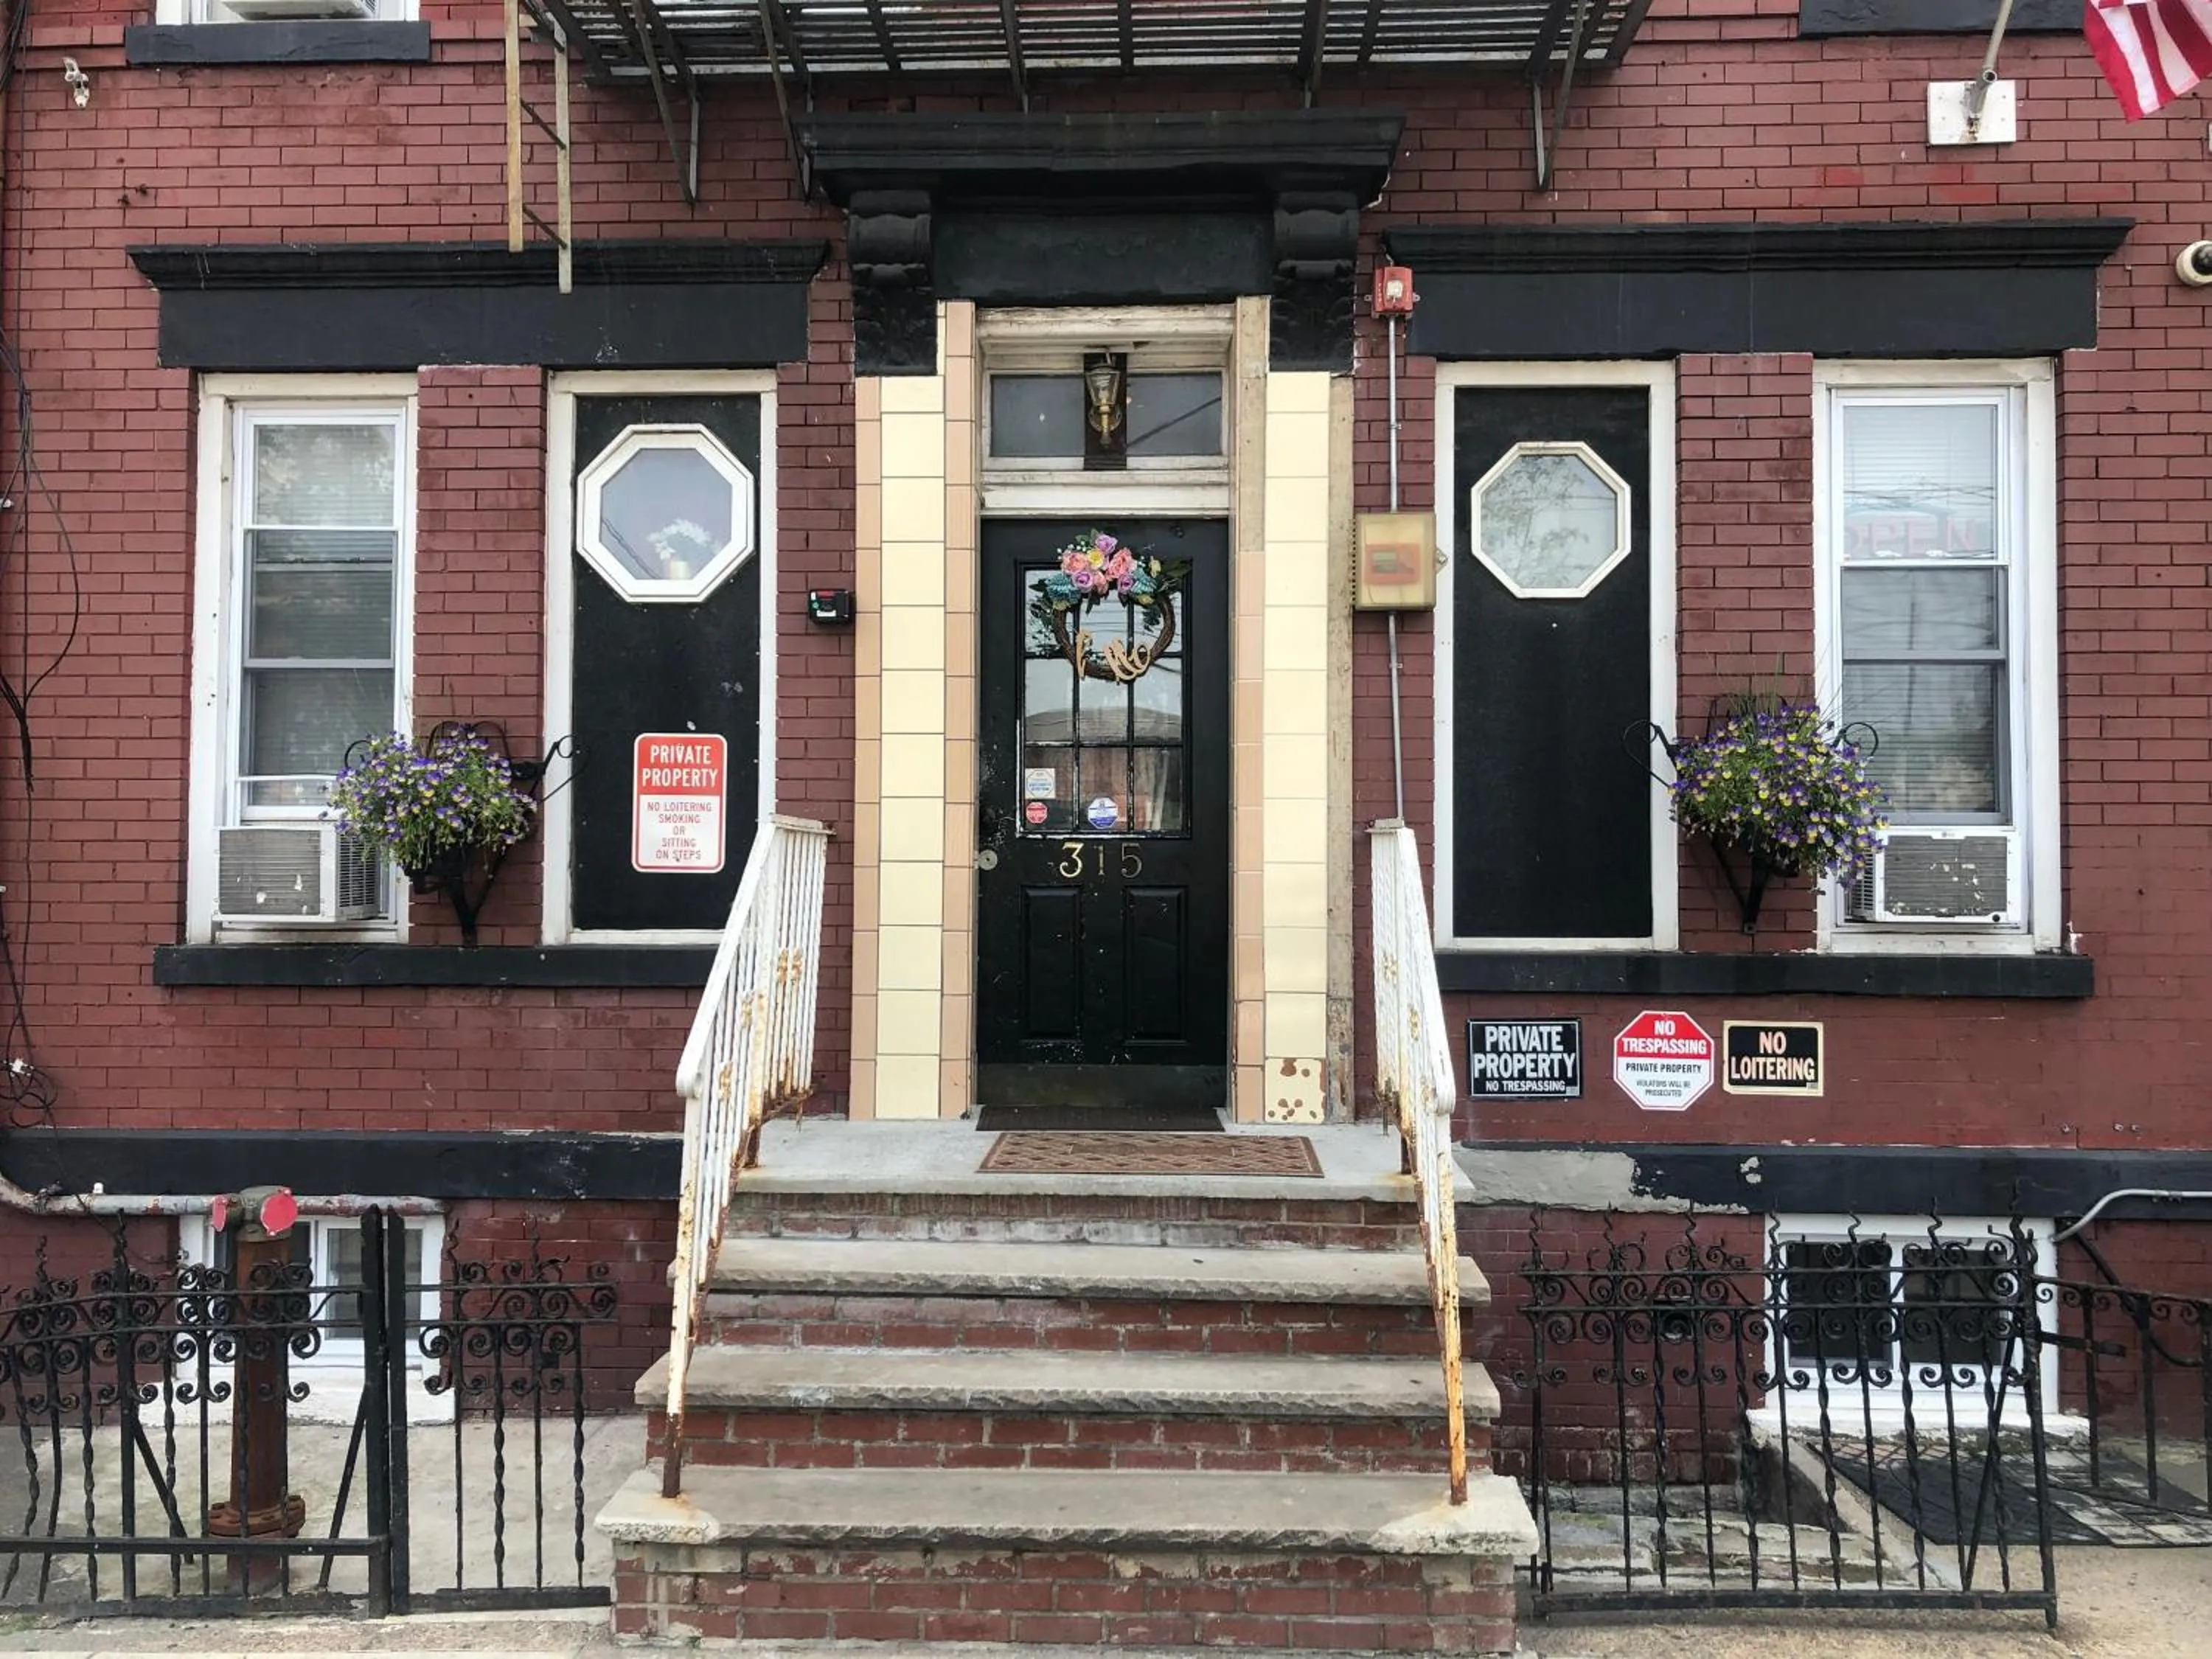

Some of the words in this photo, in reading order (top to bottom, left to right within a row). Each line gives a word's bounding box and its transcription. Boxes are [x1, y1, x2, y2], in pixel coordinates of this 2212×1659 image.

[650, 745, 712, 765] PRIVATE
[642, 768, 718, 787] PROPERTY
[647, 801, 660, 812] NO
[664, 801, 712, 812] LOITERING
[658, 814, 700, 824] SMOKING
[672, 825, 686, 835] OR
[661, 838, 696, 847] SITTING
[655, 849, 669, 860] ON
[672, 850, 701, 860] STEPS
[1060, 841, 1142, 878] 315
[1654, 1020, 1676, 1036] NO
[1484, 1026, 1564, 1052] PRIVATE
[1622, 1037, 1707, 1054] TRESPASSING
[1759, 1032, 1786, 1054] NO
[1474, 1052, 1576, 1079] PROPERTY
[1626, 1062, 1658, 1073] PRIVATE
[1660, 1063, 1702, 1074] PROPERTY
[1731, 1056, 1815, 1081] LOITERING
[1486, 1080, 1499, 1092] NO
[1502, 1080, 1566, 1093] TRESPASSING
[1636, 1079, 1667, 1088] VIOLATORS
[1669, 1080, 1682, 1088] WILL
